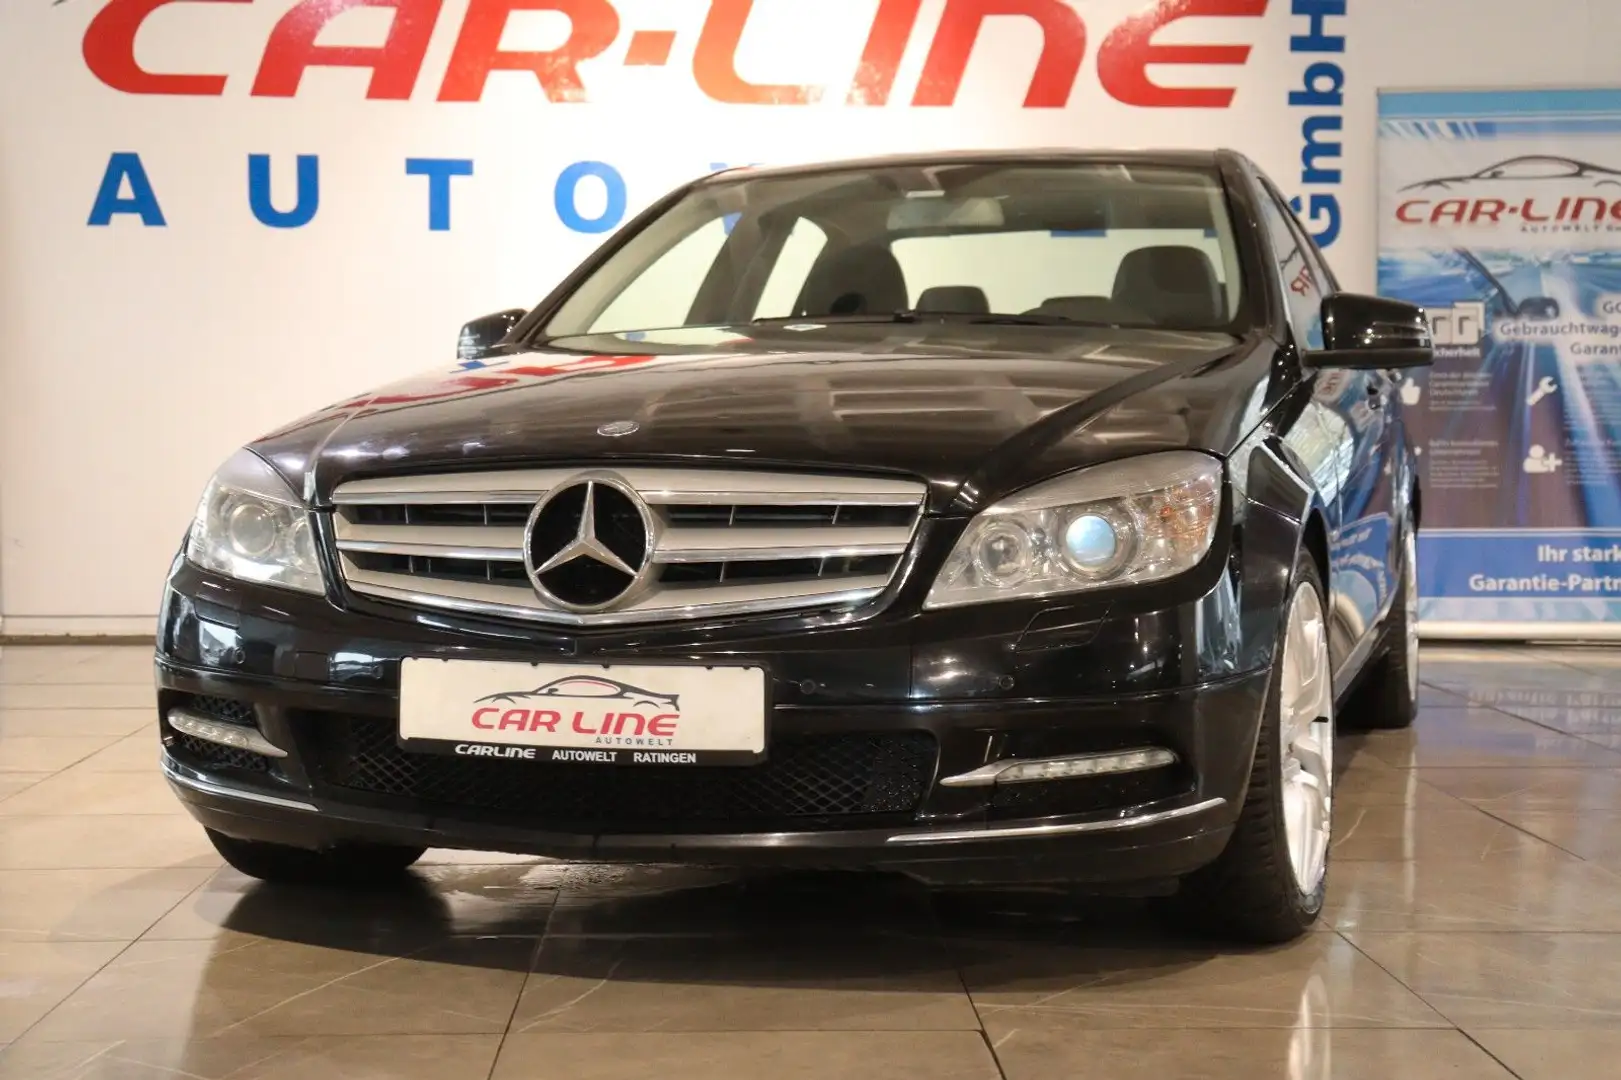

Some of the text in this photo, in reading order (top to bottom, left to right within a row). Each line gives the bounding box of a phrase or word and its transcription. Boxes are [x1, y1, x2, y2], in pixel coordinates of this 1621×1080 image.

[1287, 0, 1347, 250] GmbH
[86, 152, 765, 235] AUTO
[1537, 544, 1568, 562] Ihr
[471, 707, 680, 736] CAR LINE
[455, 743, 696, 763] CARLINE AUTOWELT RATINGEN
[596, 736, 673, 746] AUTOWELT
